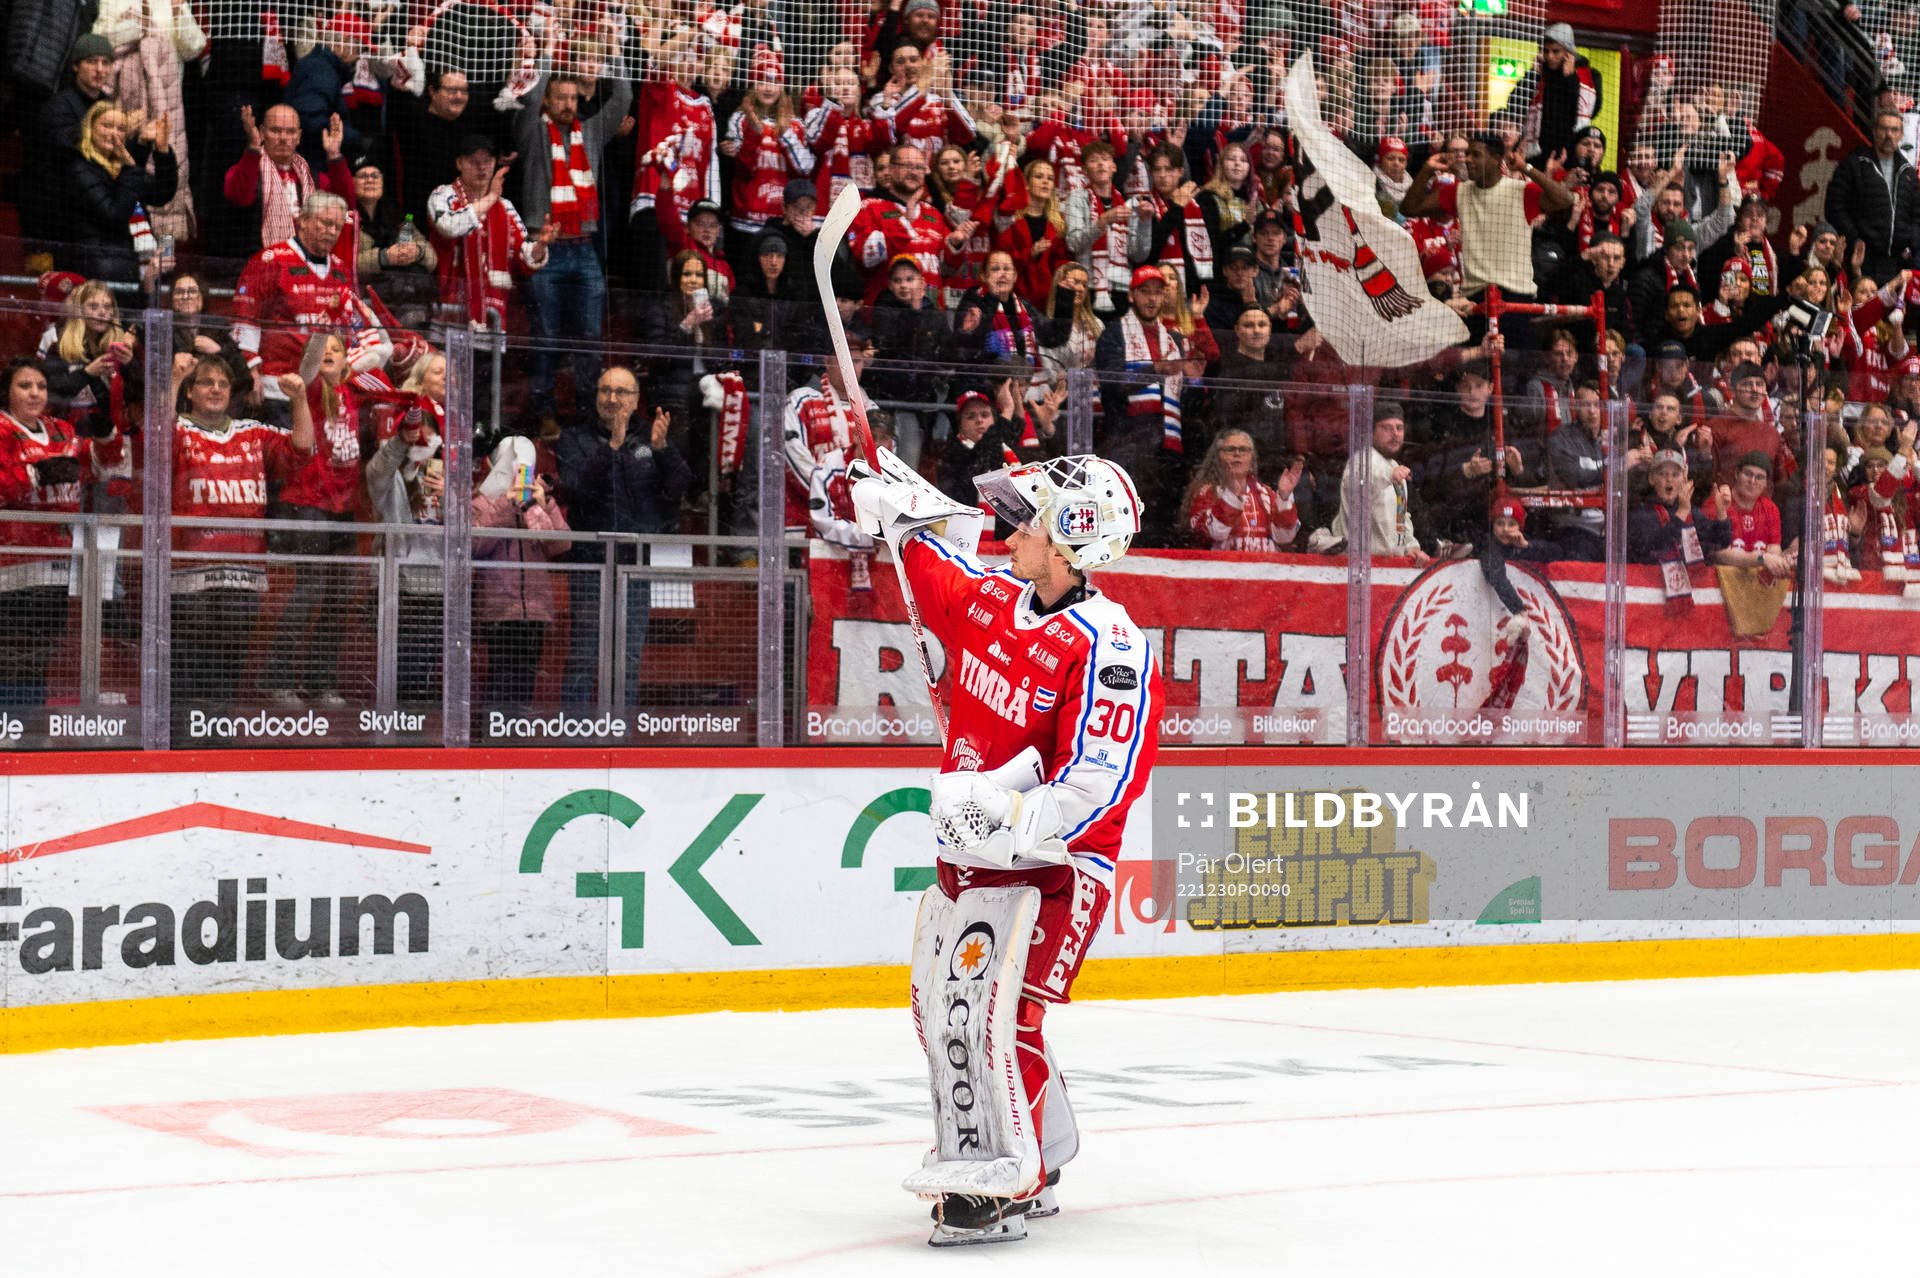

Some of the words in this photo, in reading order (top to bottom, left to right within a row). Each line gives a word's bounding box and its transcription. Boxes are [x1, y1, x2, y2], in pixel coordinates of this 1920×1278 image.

[991, 586, 1010, 603] SCA
[1056, 629, 1075, 646] SCA
[959, 647, 1031, 728] TIMRÅ
[49, 714, 127, 737] Bildekor
[189, 709, 329, 738] Brandcode
[359, 710, 426, 733] Skyltar
[489, 711, 627, 738] Brandcode
[637, 712, 741, 736] Sportpriser
[806, 711, 935, 738] Brandcode
[1087, 698, 1135, 744] 30
[1252, 713, 1318, 735] Bildekor
[1387, 710, 1494, 737] Brandcode
[1501, 716, 1583, 735] Sportpriser
[1666, 717, 1764, 739] Brandcode
[1607, 815, 1920, 891] BORG
[518, 788, 767, 949] GK
[1045, 873, 1097, 996] PEAB
[946, 998, 980, 1153] COOR
